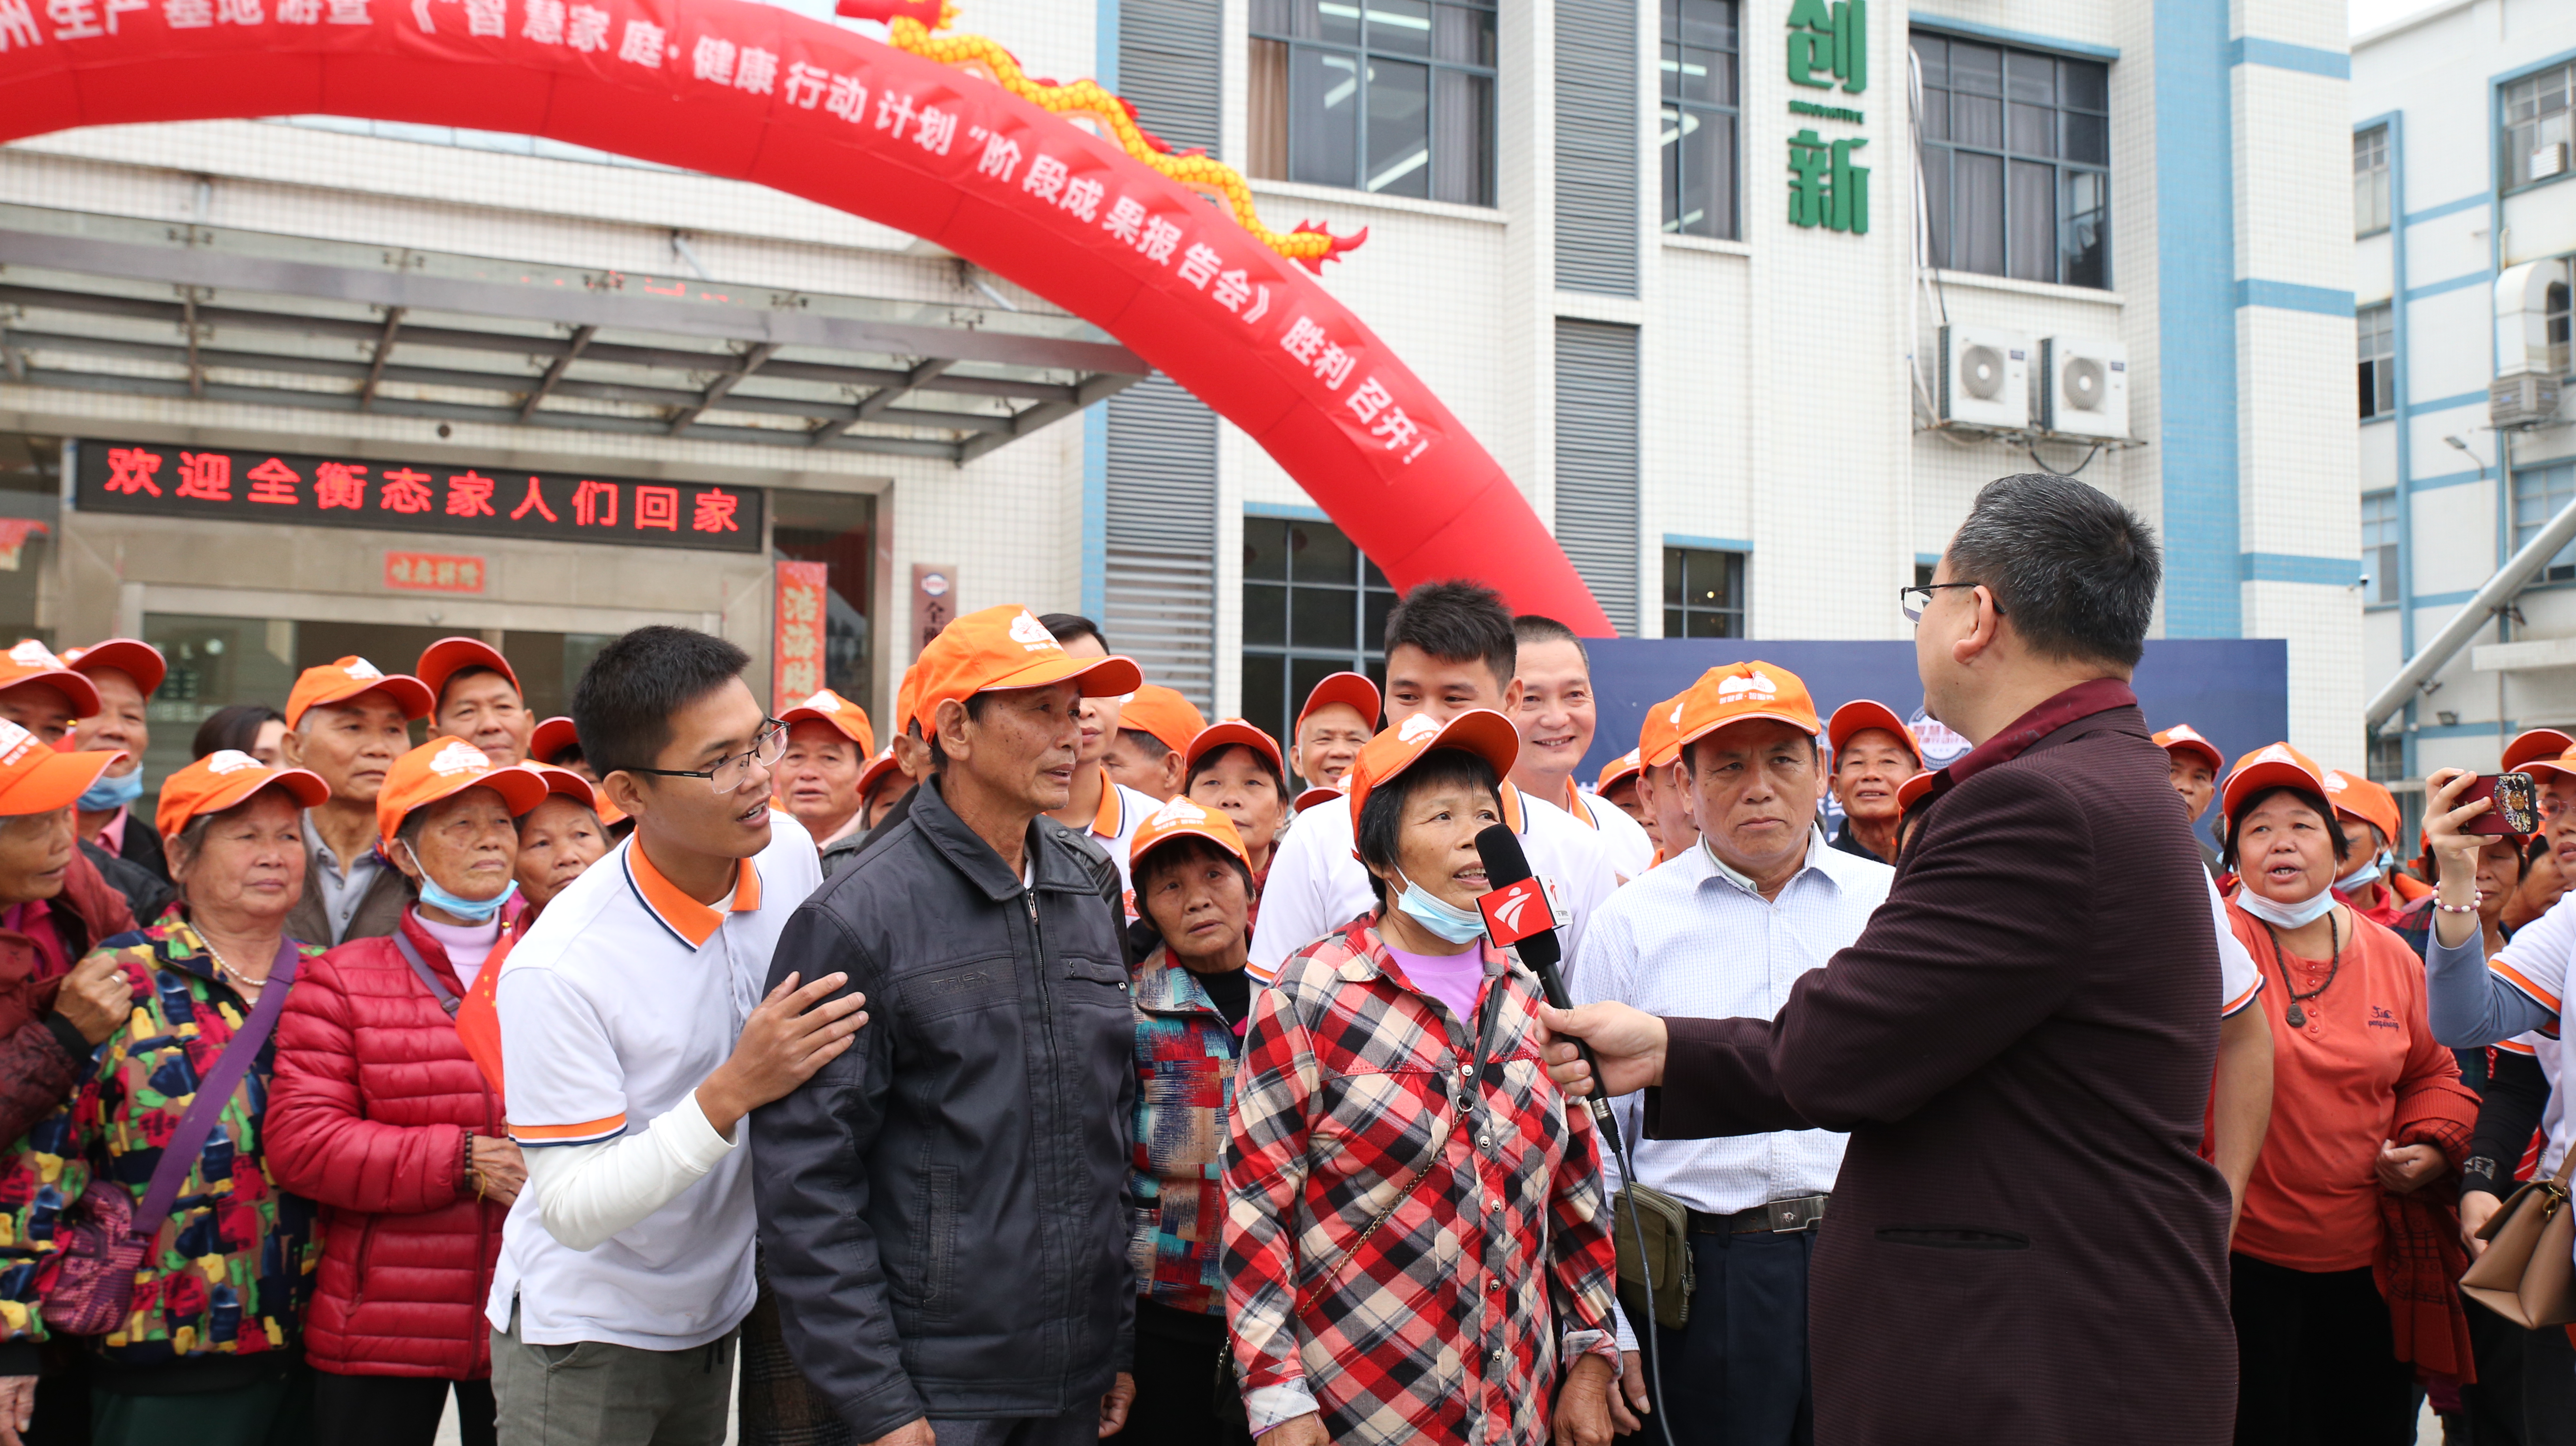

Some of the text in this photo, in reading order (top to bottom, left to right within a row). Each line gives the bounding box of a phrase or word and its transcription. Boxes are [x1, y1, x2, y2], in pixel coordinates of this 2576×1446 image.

[104, 447, 739, 533] 欢迎全衡态家人们回家
